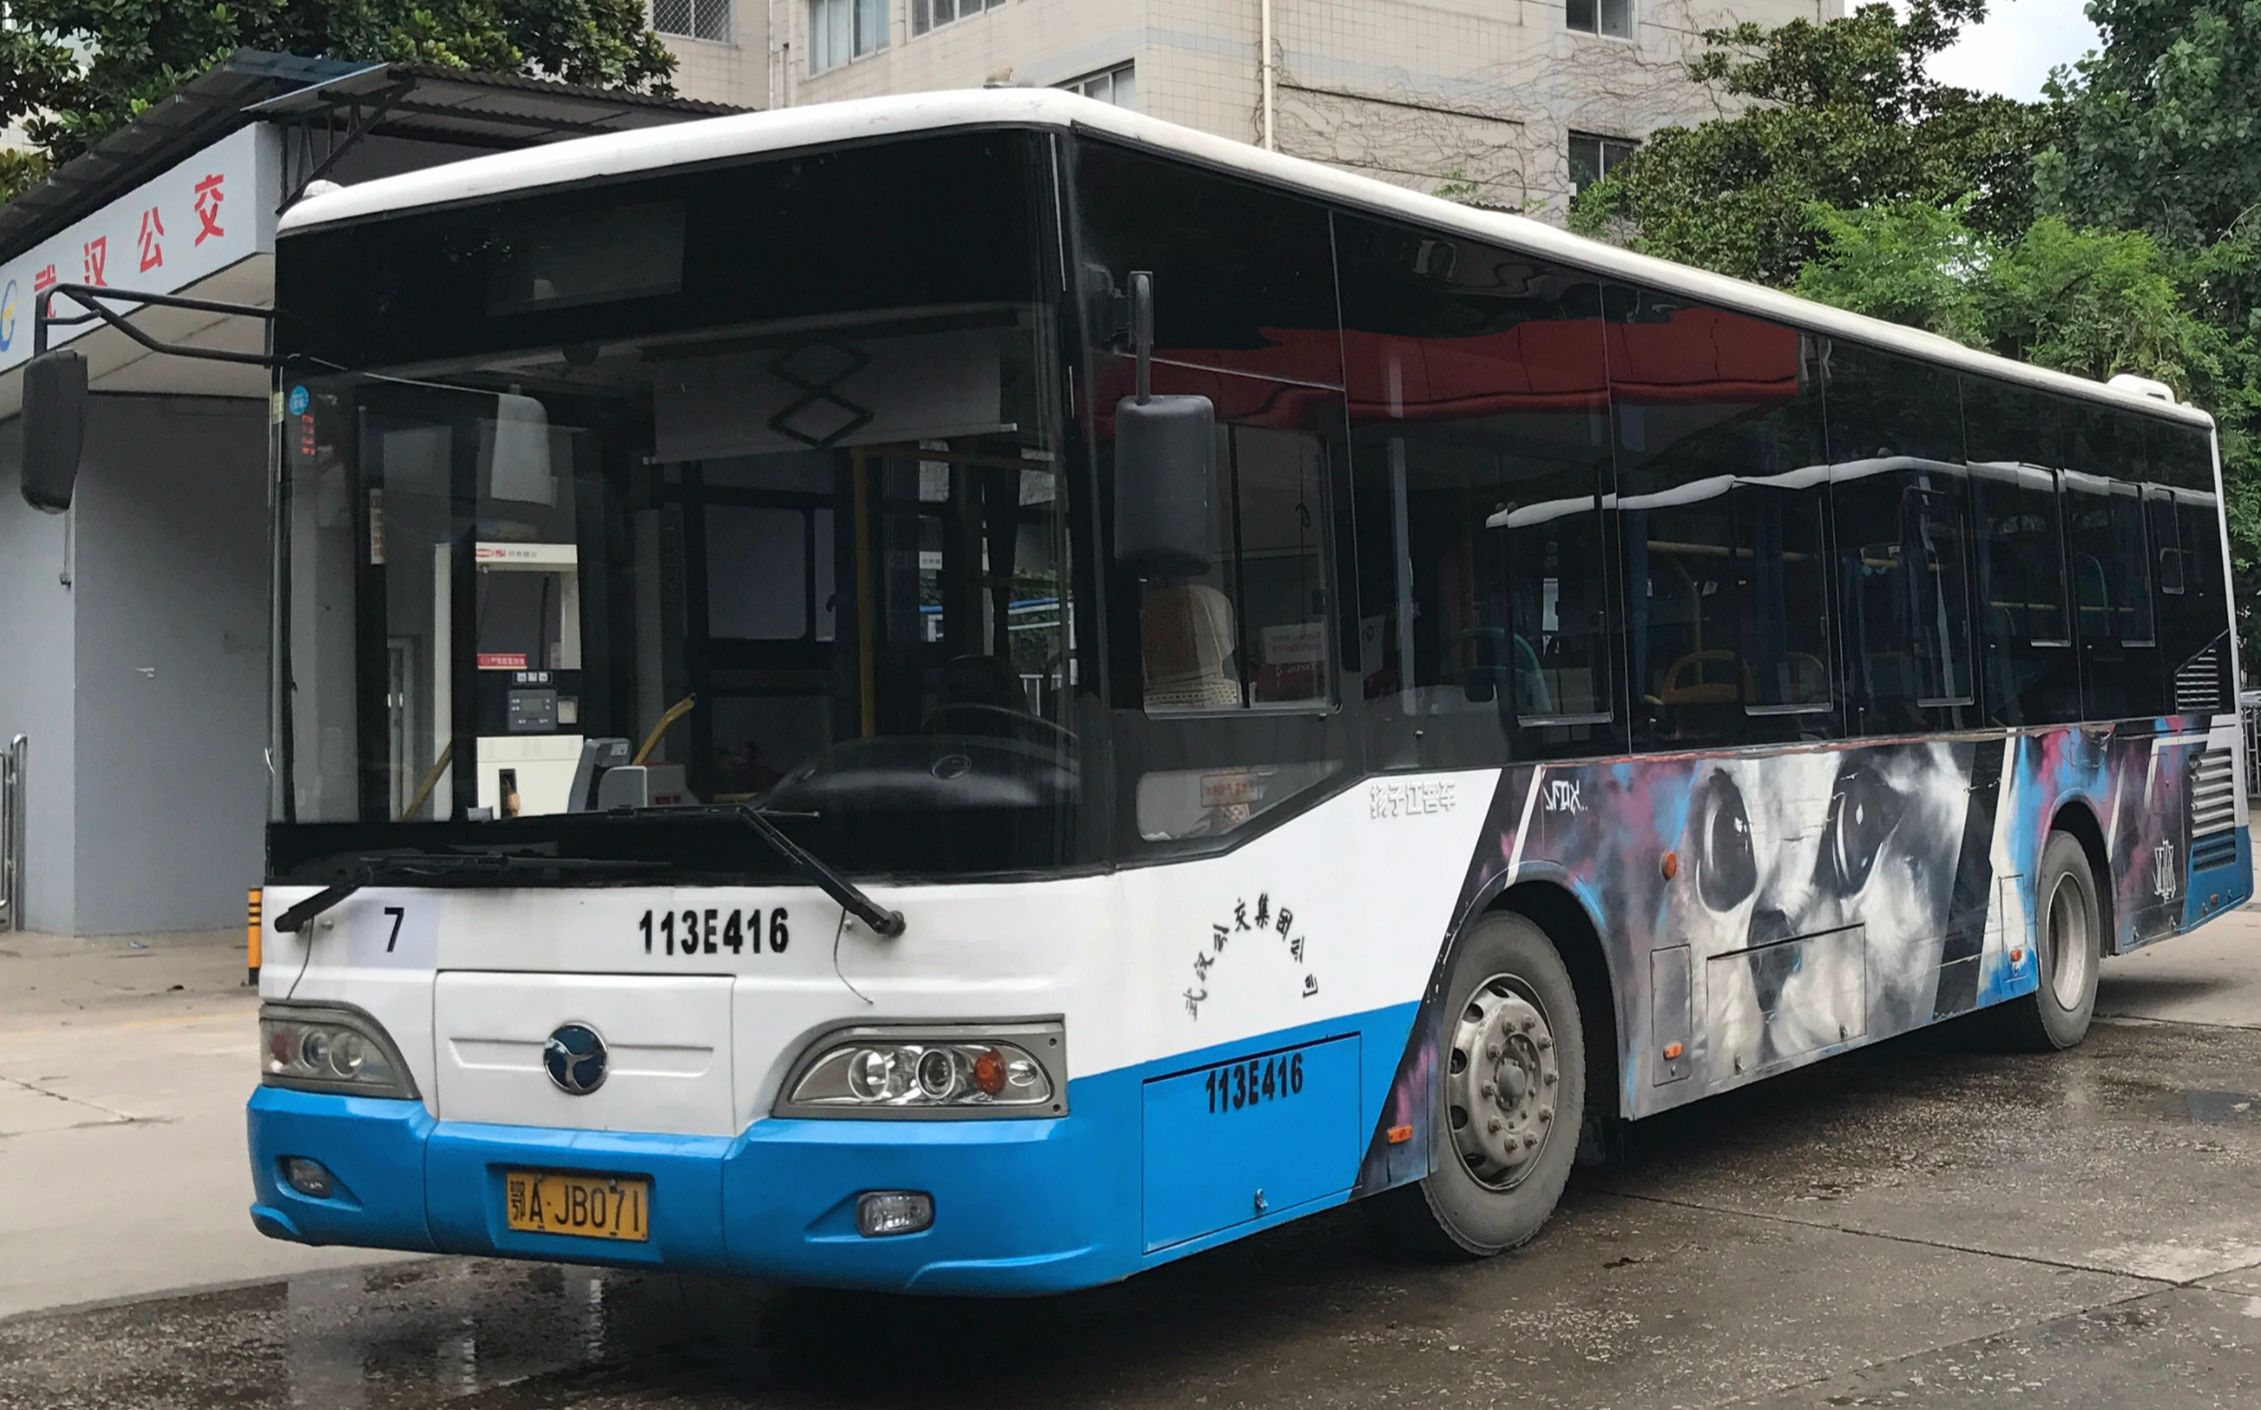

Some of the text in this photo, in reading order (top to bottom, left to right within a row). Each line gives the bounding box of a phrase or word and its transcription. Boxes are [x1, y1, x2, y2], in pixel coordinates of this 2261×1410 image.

[384, 906, 404, 953] 7
[639, 907, 789, 955] 113E416
[1183, 893, 1318, 1021] 武汉公交集团公司
[1206, 1053, 1303, 1114] 113E416
